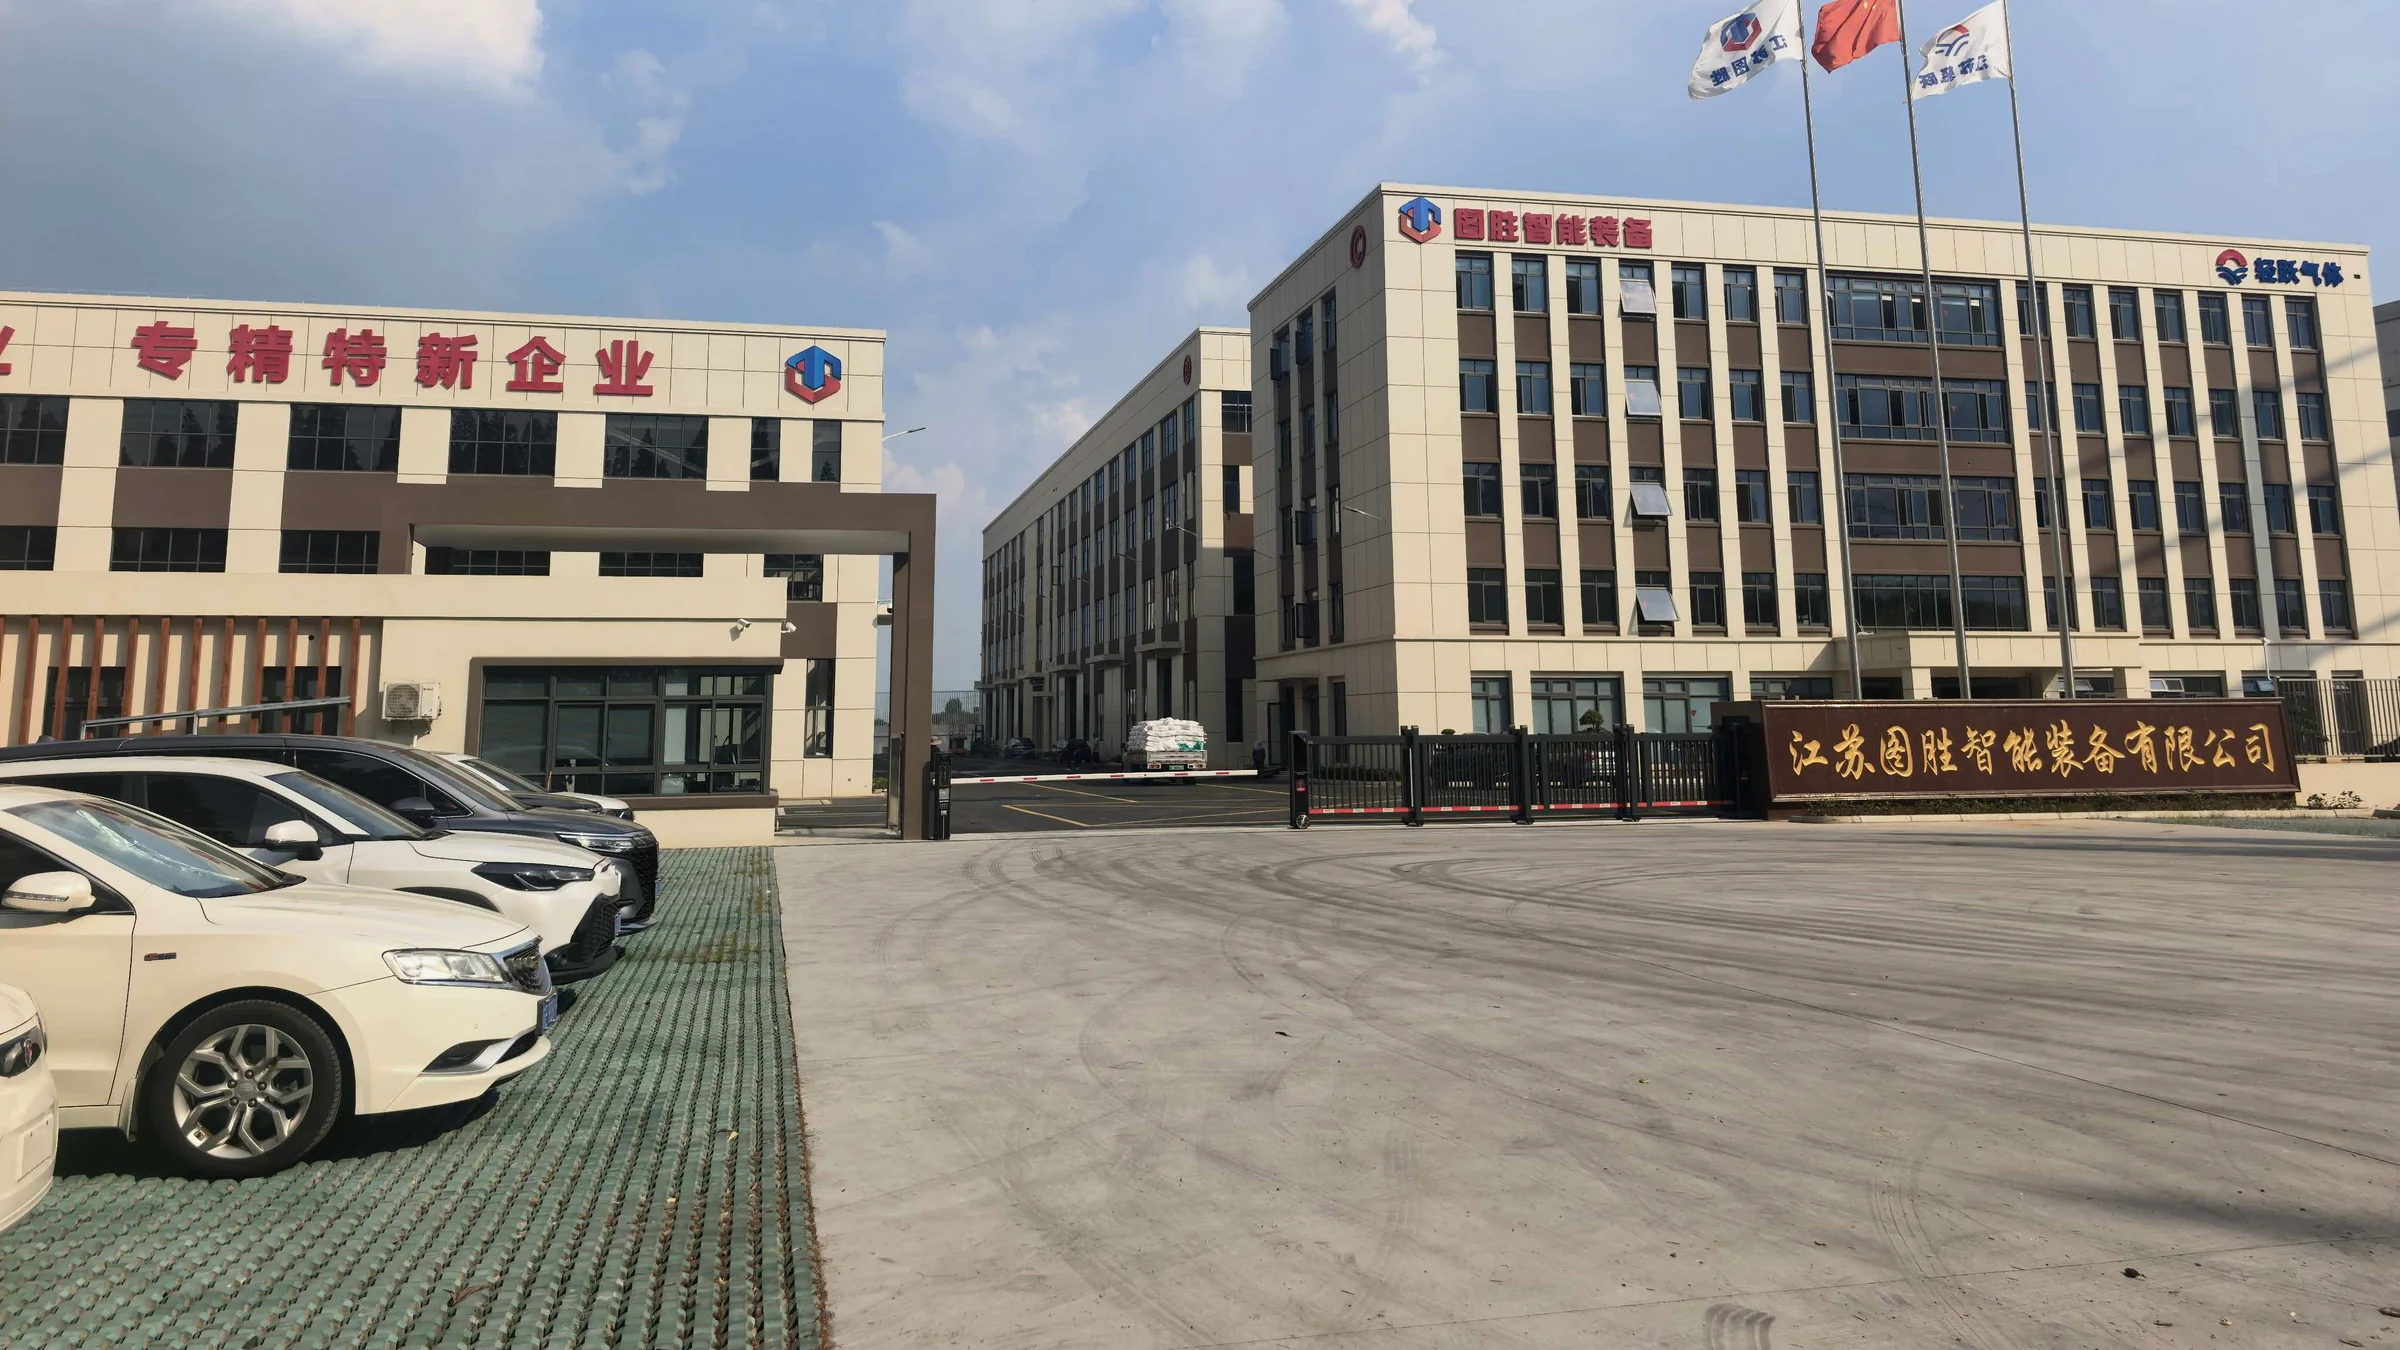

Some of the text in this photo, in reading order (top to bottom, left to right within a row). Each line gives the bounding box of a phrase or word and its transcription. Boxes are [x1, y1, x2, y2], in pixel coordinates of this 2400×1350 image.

[1454, 208, 1652, 248] 图胜智能装备
[2253, 257, 2344, 287] 轻跃气体
[131, 320, 655, 396] 专精特新企业
[1789, 719, 2275, 780] 江苏图胜智能装备有限公司
